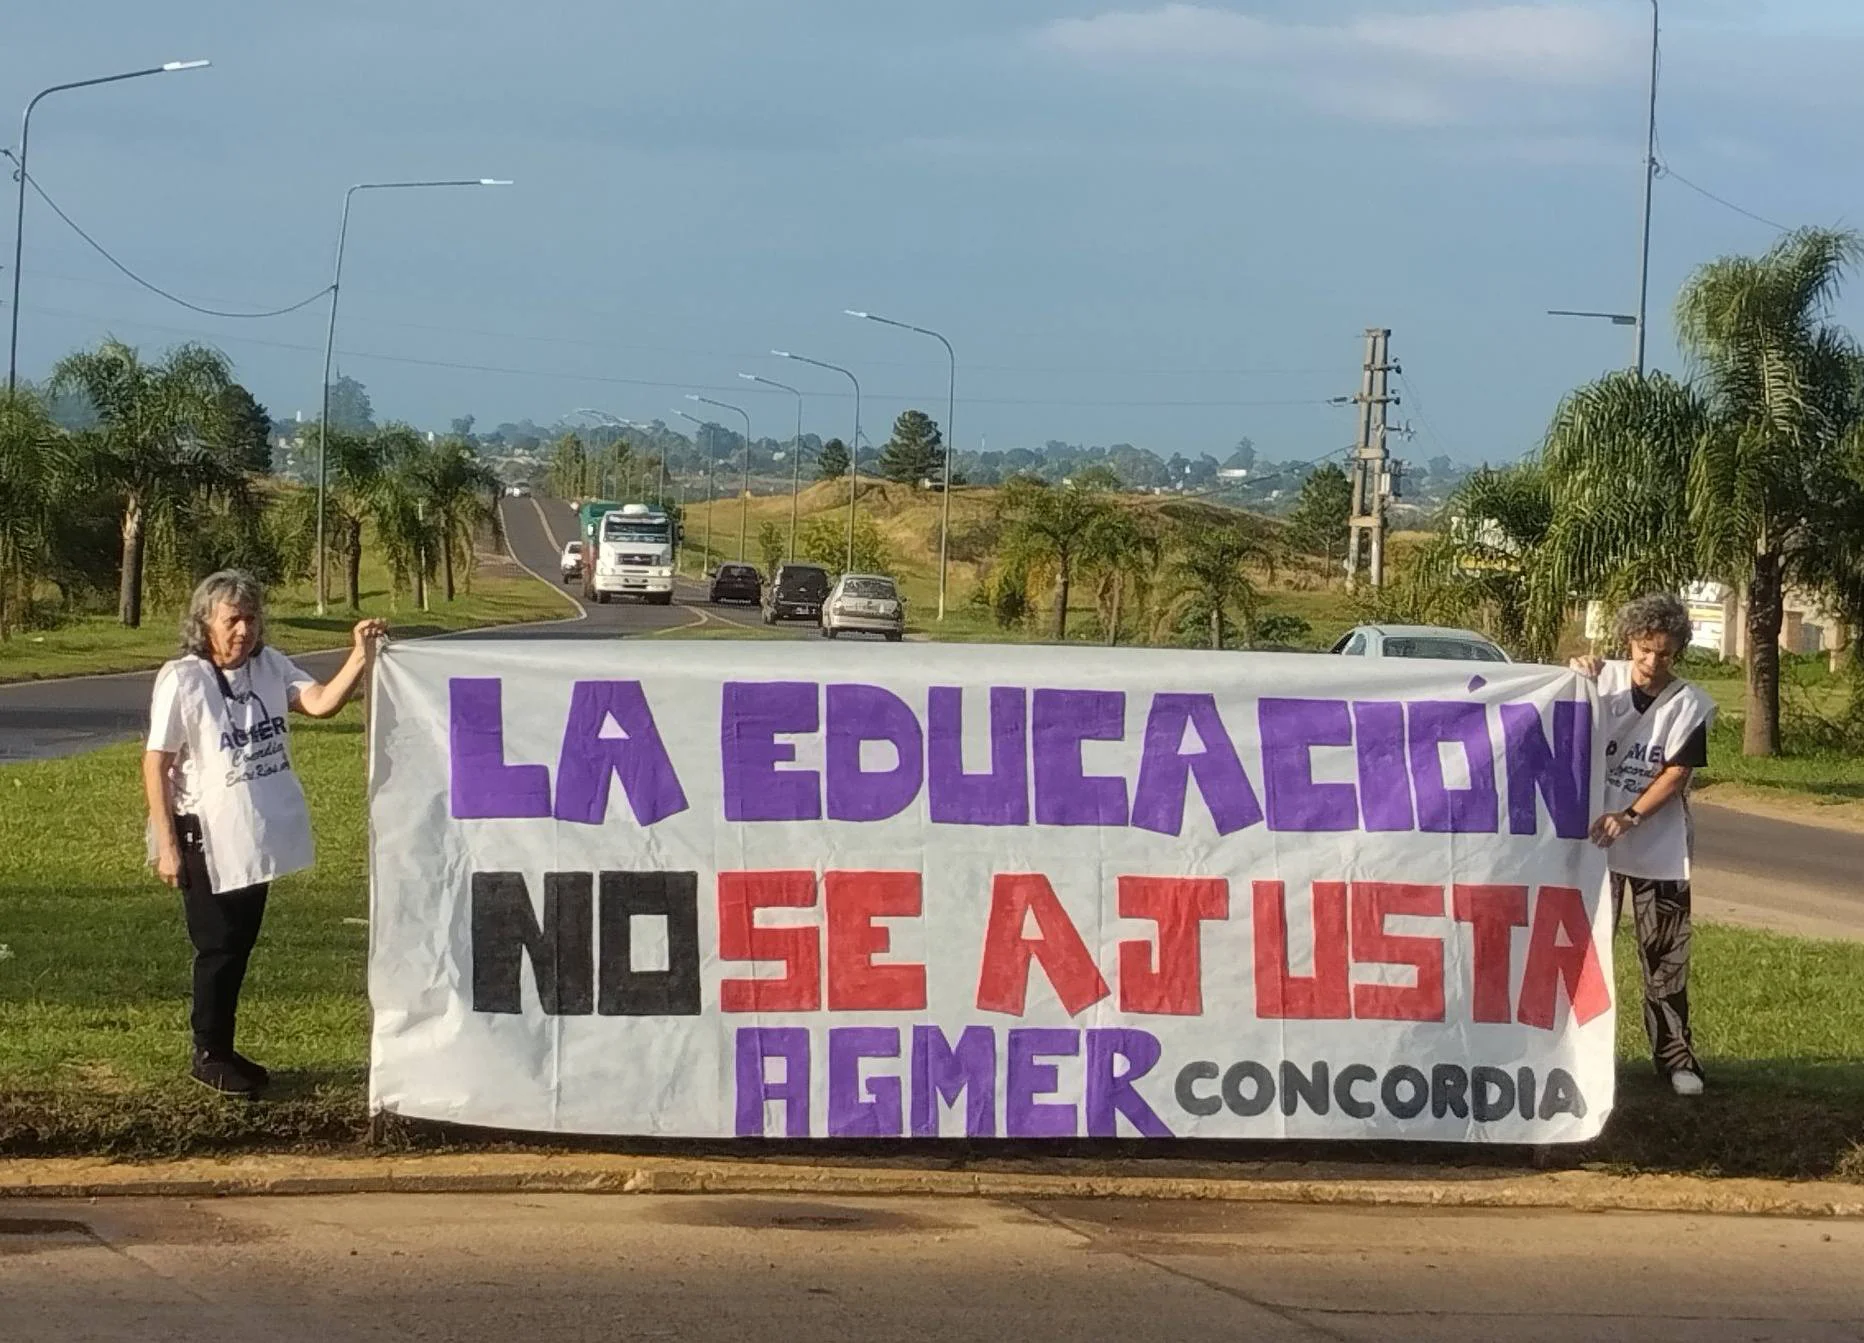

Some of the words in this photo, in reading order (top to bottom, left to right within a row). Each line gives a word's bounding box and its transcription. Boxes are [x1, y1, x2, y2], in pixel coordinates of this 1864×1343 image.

[449, 677, 690, 827] LA
[721, 674, 1592, 839] EDUCACIÓN
[471, 870, 702, 1016] NO
[717, 870, 927, 1012] SE
[976, 873, 1611, 1030] AJUSTA
[735, 1025, 1178, 1139] AGMER
[1174, 1060, 1588, 1122] CONCORDIA
